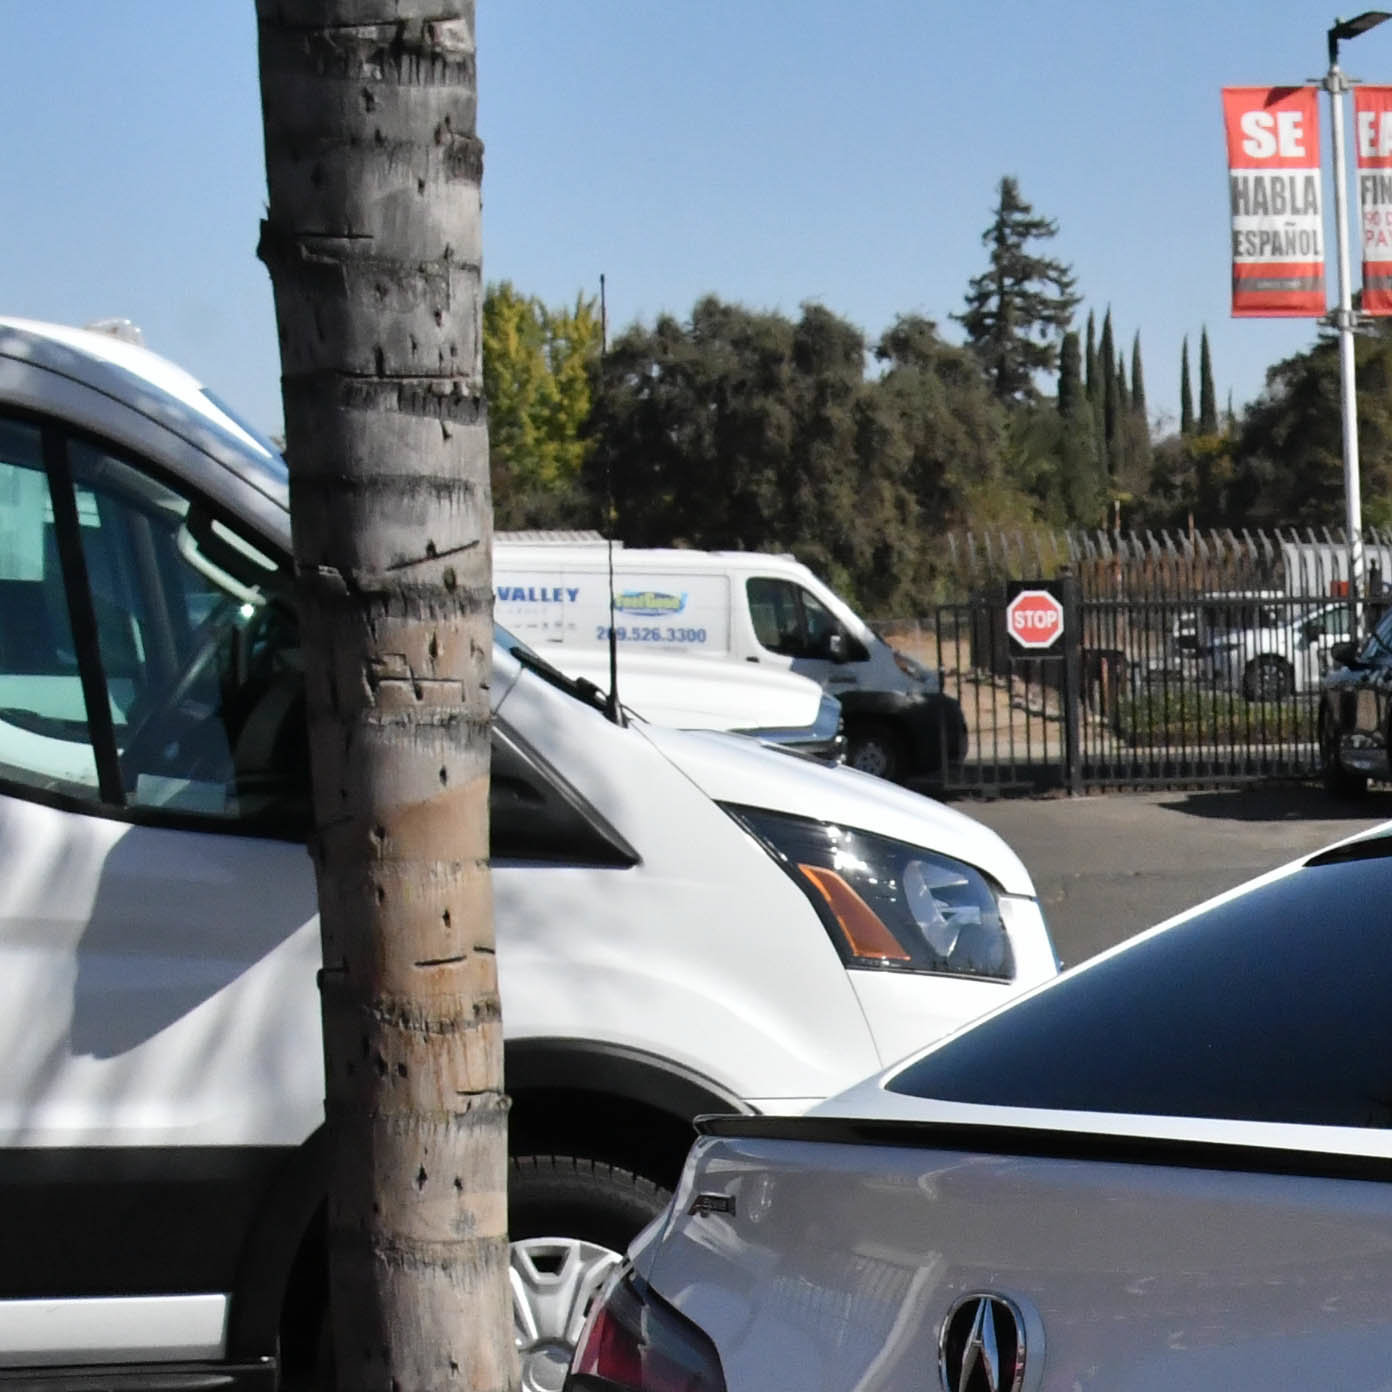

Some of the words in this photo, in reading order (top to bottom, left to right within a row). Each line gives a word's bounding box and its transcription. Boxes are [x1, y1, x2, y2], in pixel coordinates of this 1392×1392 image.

[1240, 111, 1305, 158] SE
[1232, 175, 1318, 216] HABLA
[497, 586, 579, 602] VALLEY
[1013, 609, 1058, 629] STOP
[596, 626, 707, 644] 29.526.3300
